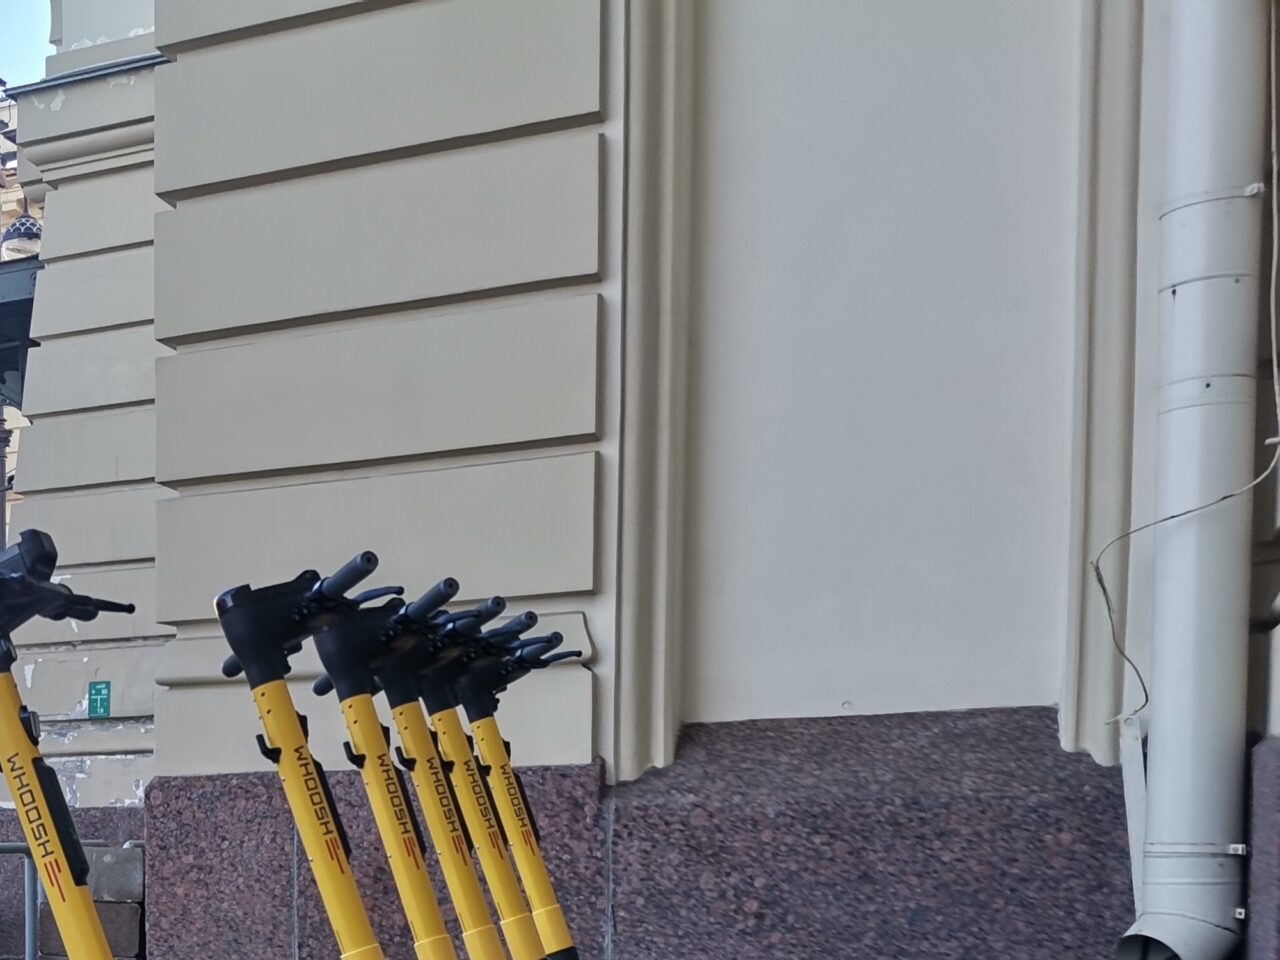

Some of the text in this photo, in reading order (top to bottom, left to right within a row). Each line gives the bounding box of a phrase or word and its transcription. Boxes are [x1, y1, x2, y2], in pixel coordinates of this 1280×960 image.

[6, 751, 55, 859] WHOOSH
[293, 744, 334, 836] WHOOSH
[377, 753, 412, 835] WHOOSH
[426, 756, 459, 833] WHOOSH
[463, 759, 496, 830] WHOOSH
[500, 763, 529, 829] WHOOSH
